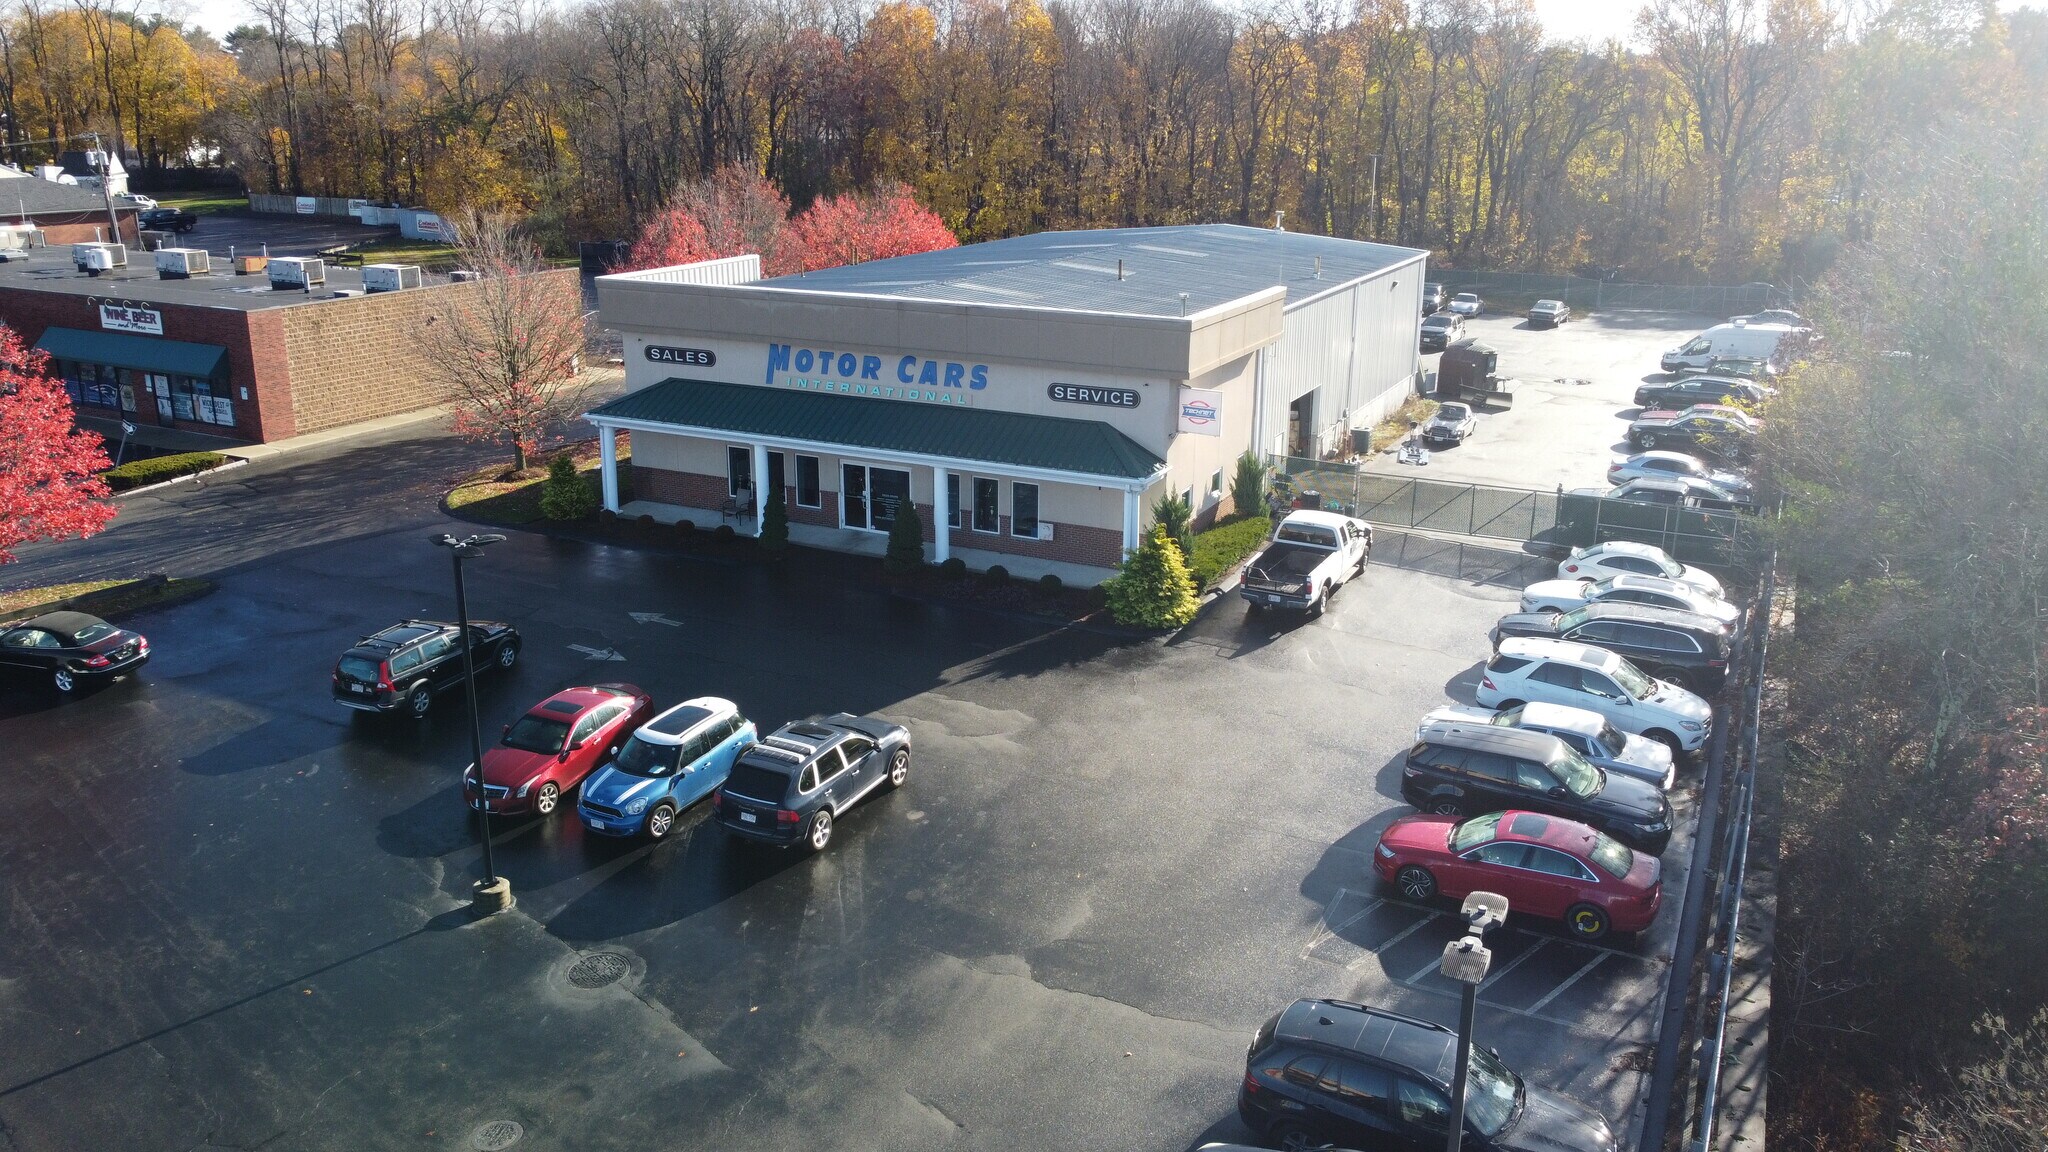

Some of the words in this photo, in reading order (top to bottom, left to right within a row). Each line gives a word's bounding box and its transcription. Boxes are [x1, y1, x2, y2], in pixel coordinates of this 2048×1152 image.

[131, 311, 157, 325] BEER
[131, 322, 147, 330] More
[651, 348, 708, 364] SALES
[765, 343, 882, 385] MOTOR
[897, 355, 989, 391] CARS
[786, 377, 967, 405] INTERNATIONAL
[1054, 386, 1134, 405] SERVICE
